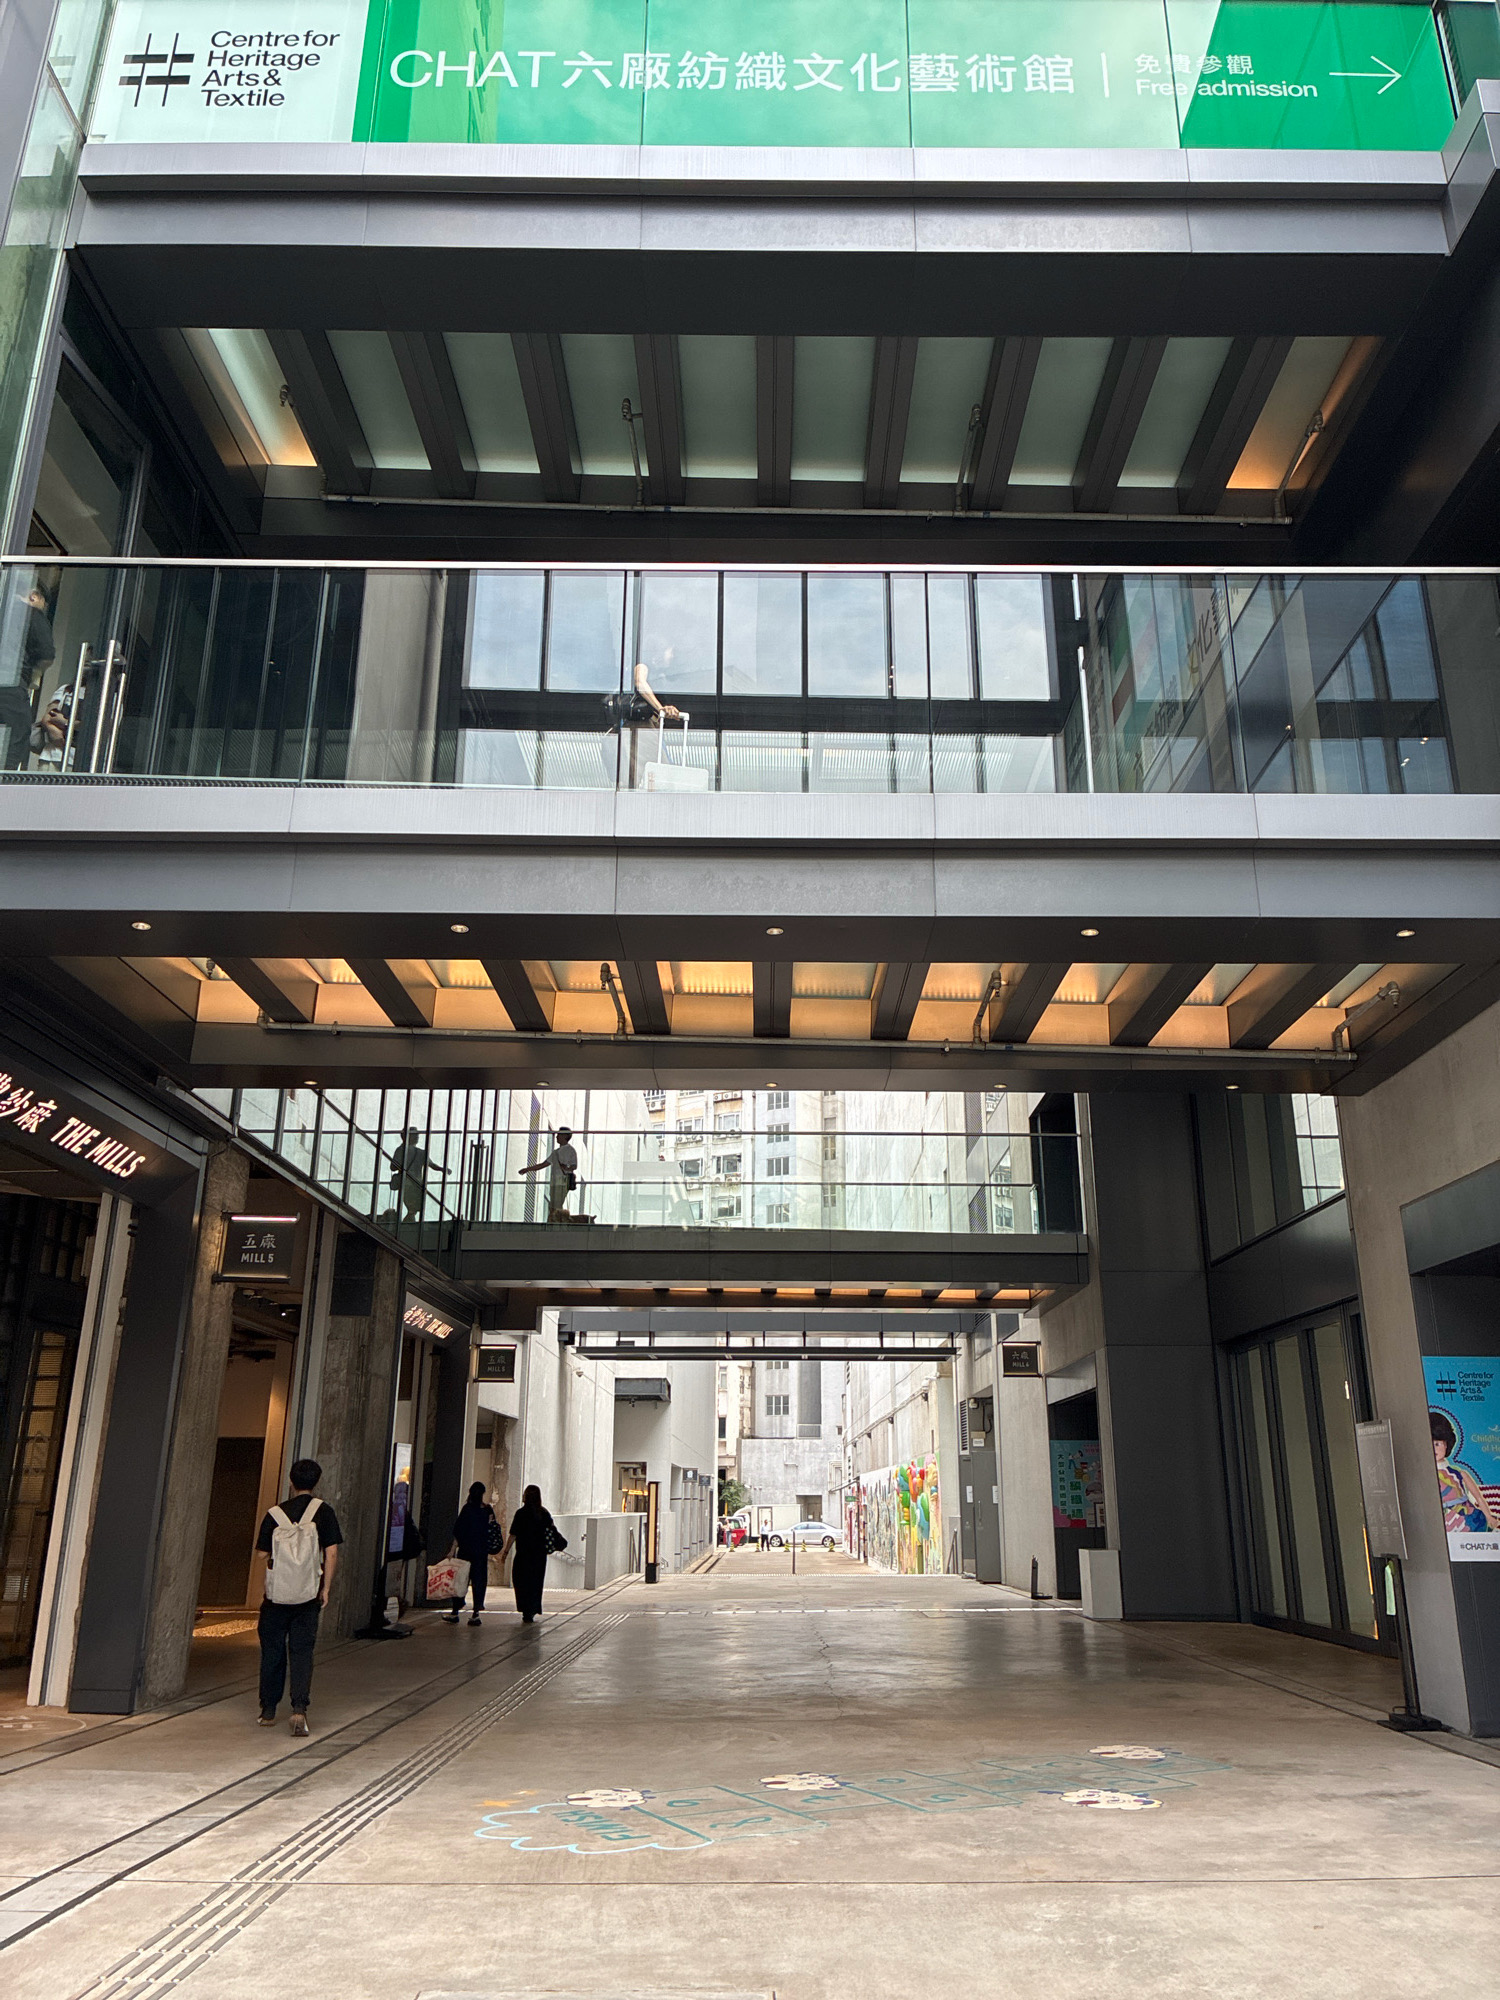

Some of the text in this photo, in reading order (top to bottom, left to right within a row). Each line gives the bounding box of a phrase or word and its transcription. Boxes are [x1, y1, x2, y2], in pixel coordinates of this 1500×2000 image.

[211, 29, 341, 48] Centre for
[207, 49, 321, 71] Heritage
[1135, 53, 1254, 76] 免費參觀
[201, 68, 282, 87] Arts &
[200, 88, 285, 107] Textile
[1136, 79, 1318, 98] Free admission
[0, 1072, 58, 1133] 紗廠
[50, 1117, 146, 1178] THE MILLS
[240, 1252, 275, 1264] MILL 5
[1457, 1371, 1494, 1380] Centre for
[1458, 1379, 1492, 1389] Heritage
[1461, 1394, 1486, 1402] Textile
[551, 1809, 652, 1841] FINISH
